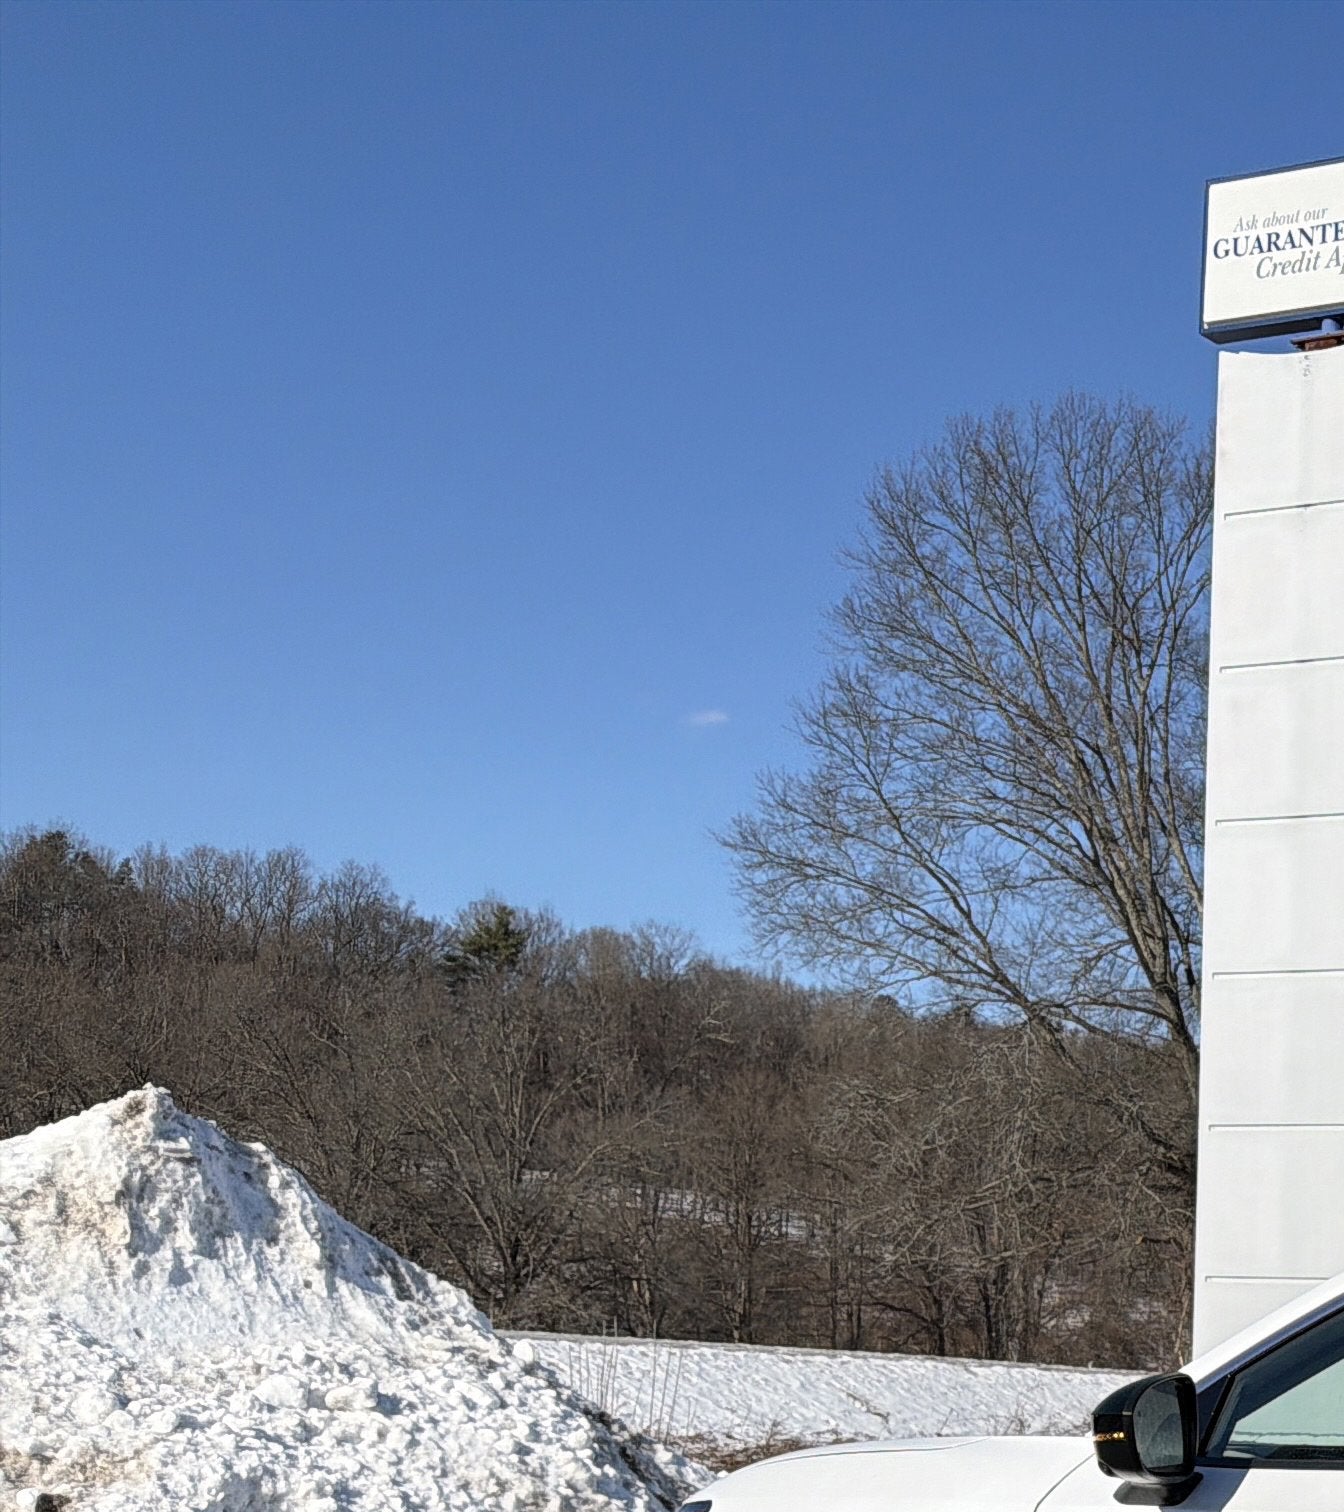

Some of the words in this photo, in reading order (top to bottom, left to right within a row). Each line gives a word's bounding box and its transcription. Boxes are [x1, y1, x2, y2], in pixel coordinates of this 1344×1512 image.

[1233, 214, 1258, 233] Ask
[1262, 210, 1300, 229] about
[1303, 207, 1328, 221] our
[1256, 249, 1321, 279] Credit
